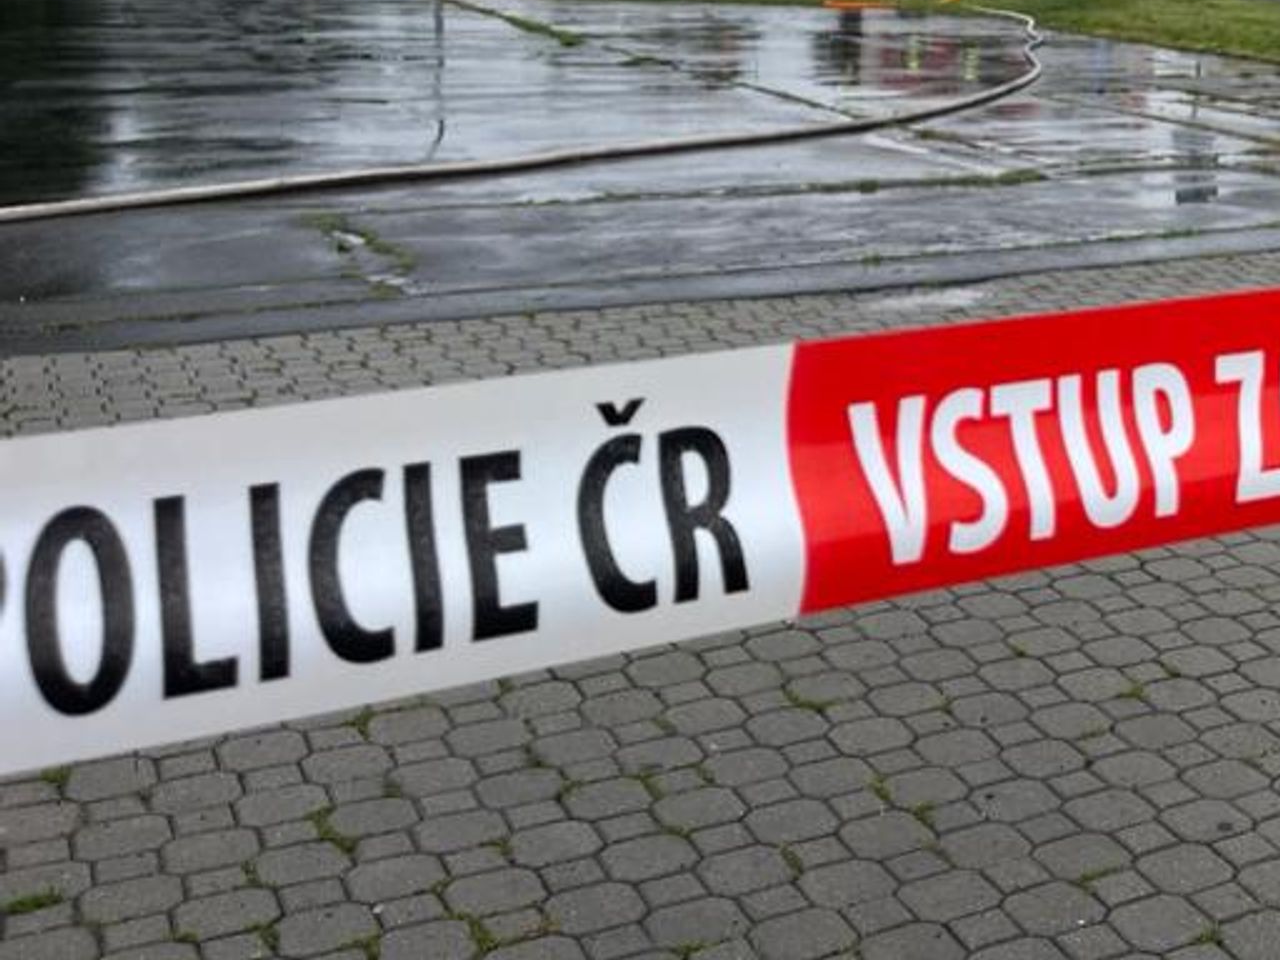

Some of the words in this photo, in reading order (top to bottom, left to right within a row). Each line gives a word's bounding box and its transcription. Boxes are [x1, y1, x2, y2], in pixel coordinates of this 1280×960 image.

[0, 450, 539, 717] OLICIE
[577, 398, 750, 614] ČR
[848, 361, 1195, 565] VSTUP
